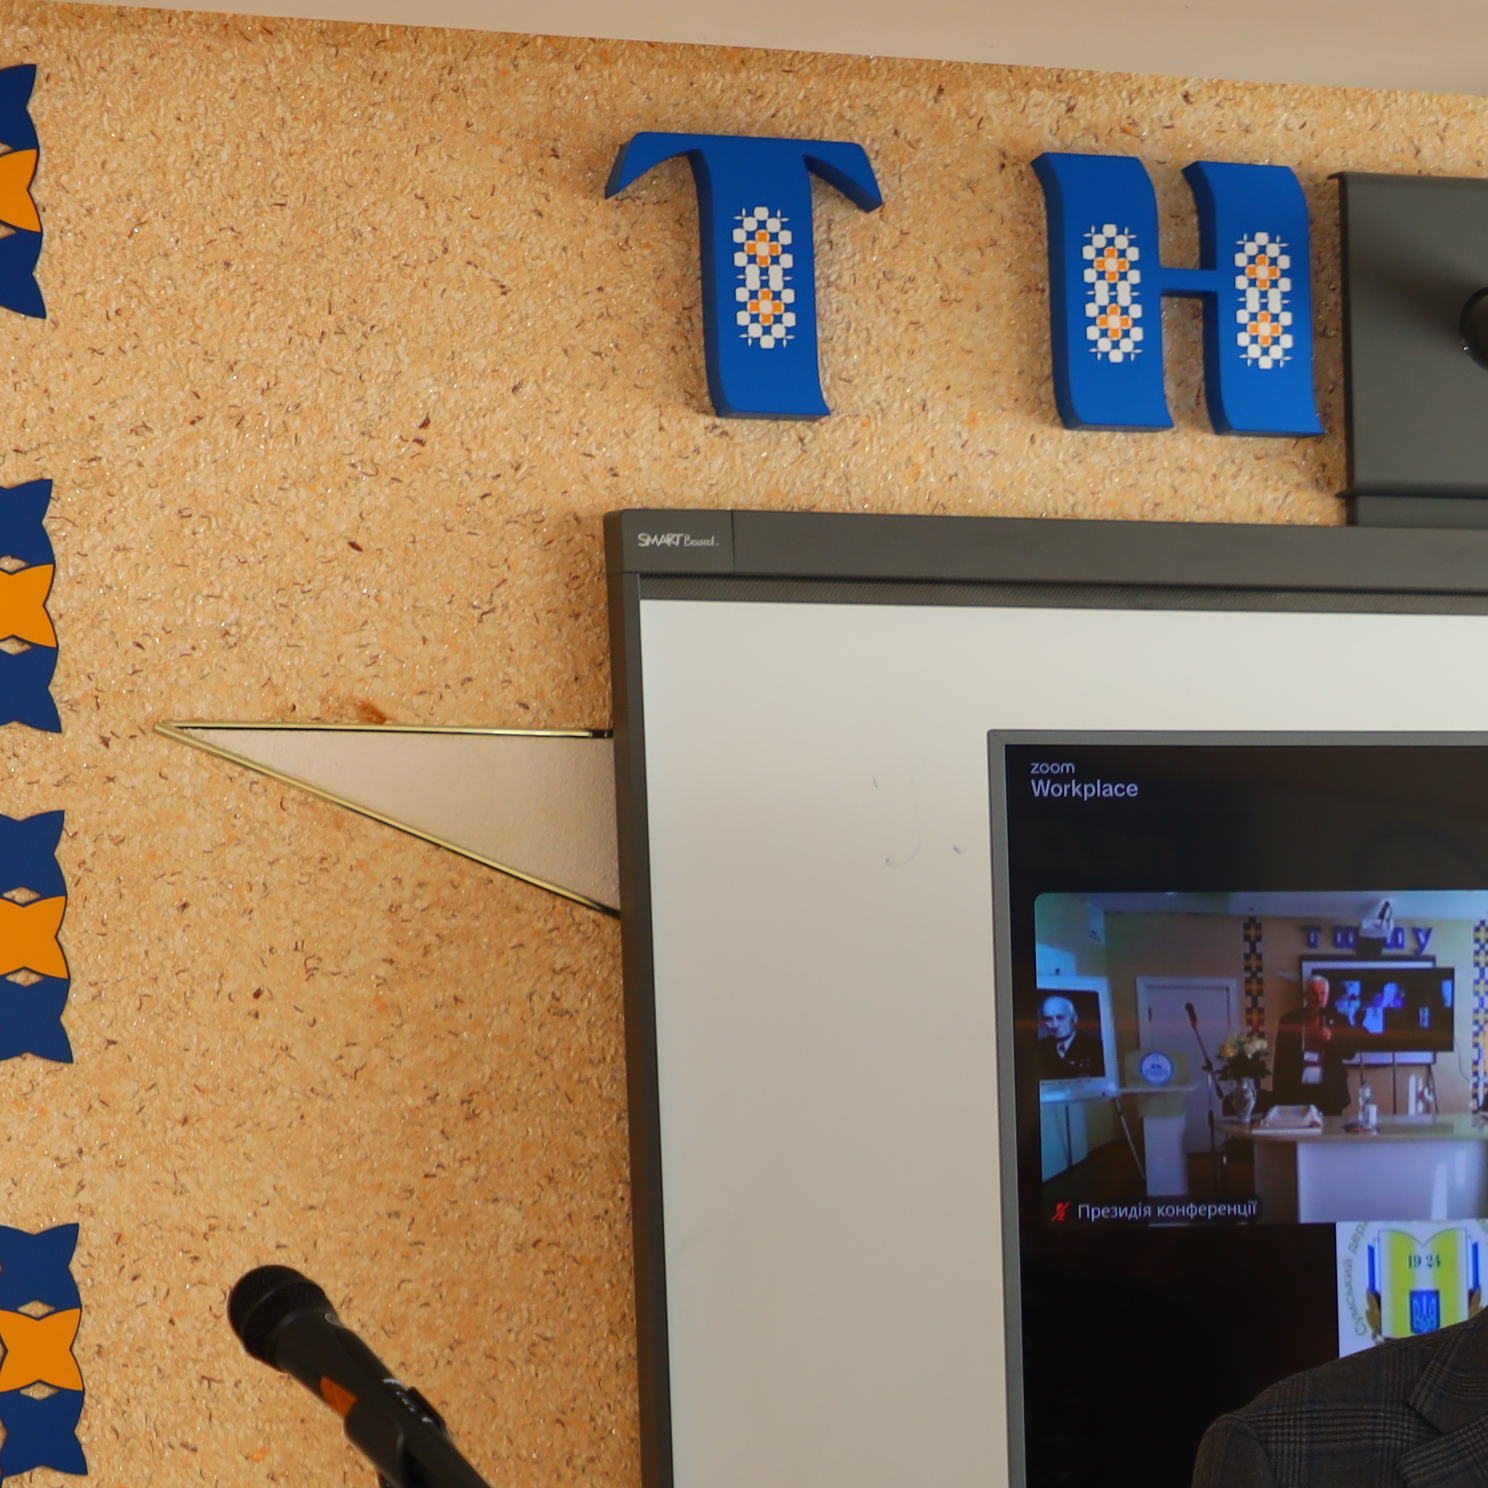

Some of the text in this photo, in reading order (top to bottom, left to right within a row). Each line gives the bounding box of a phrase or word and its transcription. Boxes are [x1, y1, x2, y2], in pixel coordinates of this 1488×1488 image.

[637, 532, 684, 547] SMART
[1030, 762, 1075, 774] zoom
[1030, 778, 1139, 801] Workplace
[1078, 1200, 1257, 1222] Президія конференції
